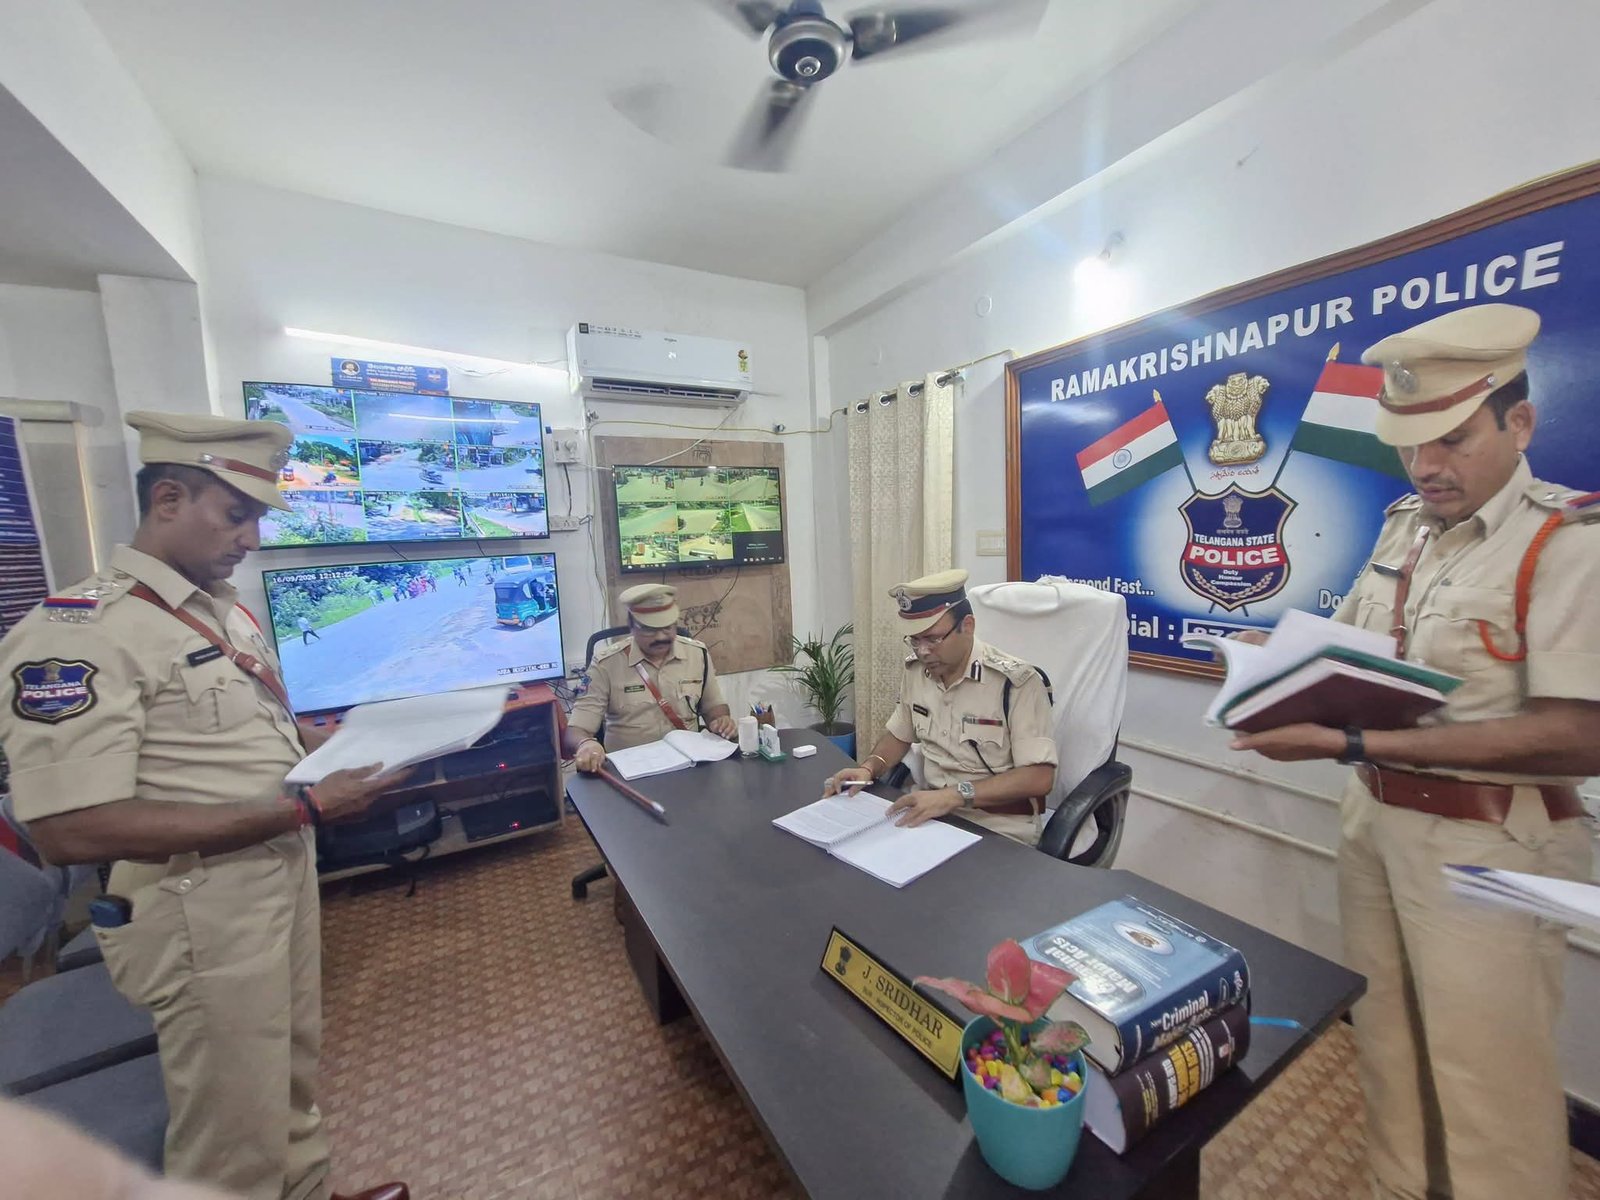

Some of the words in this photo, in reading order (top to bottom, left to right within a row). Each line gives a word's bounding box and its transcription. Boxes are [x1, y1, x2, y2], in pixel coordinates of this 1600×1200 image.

[1051, 296, 1354, 402] RAMAKRISHNAPUR
[1373, 241, 1565, 315] POLICE
[1194, 533, 1244, 547] TELANGANA
[1245, 533, 1275, 546] STATE
[1189, 545, 1280, 566] POLICE
[1128, 613, 1159, 639] ial
[22, 686, 89, 699] POLICE
[25, 681, 82, 691] TELANGANA
[862, 966, 872, 984] J.
[875, 975, 943, 1040] SRIDHAR
[1162, 990, 1209, 1031] Criminal
[904, 1020, 912, 1029] OF
[912, 1027, 932, 1047] POLICE
